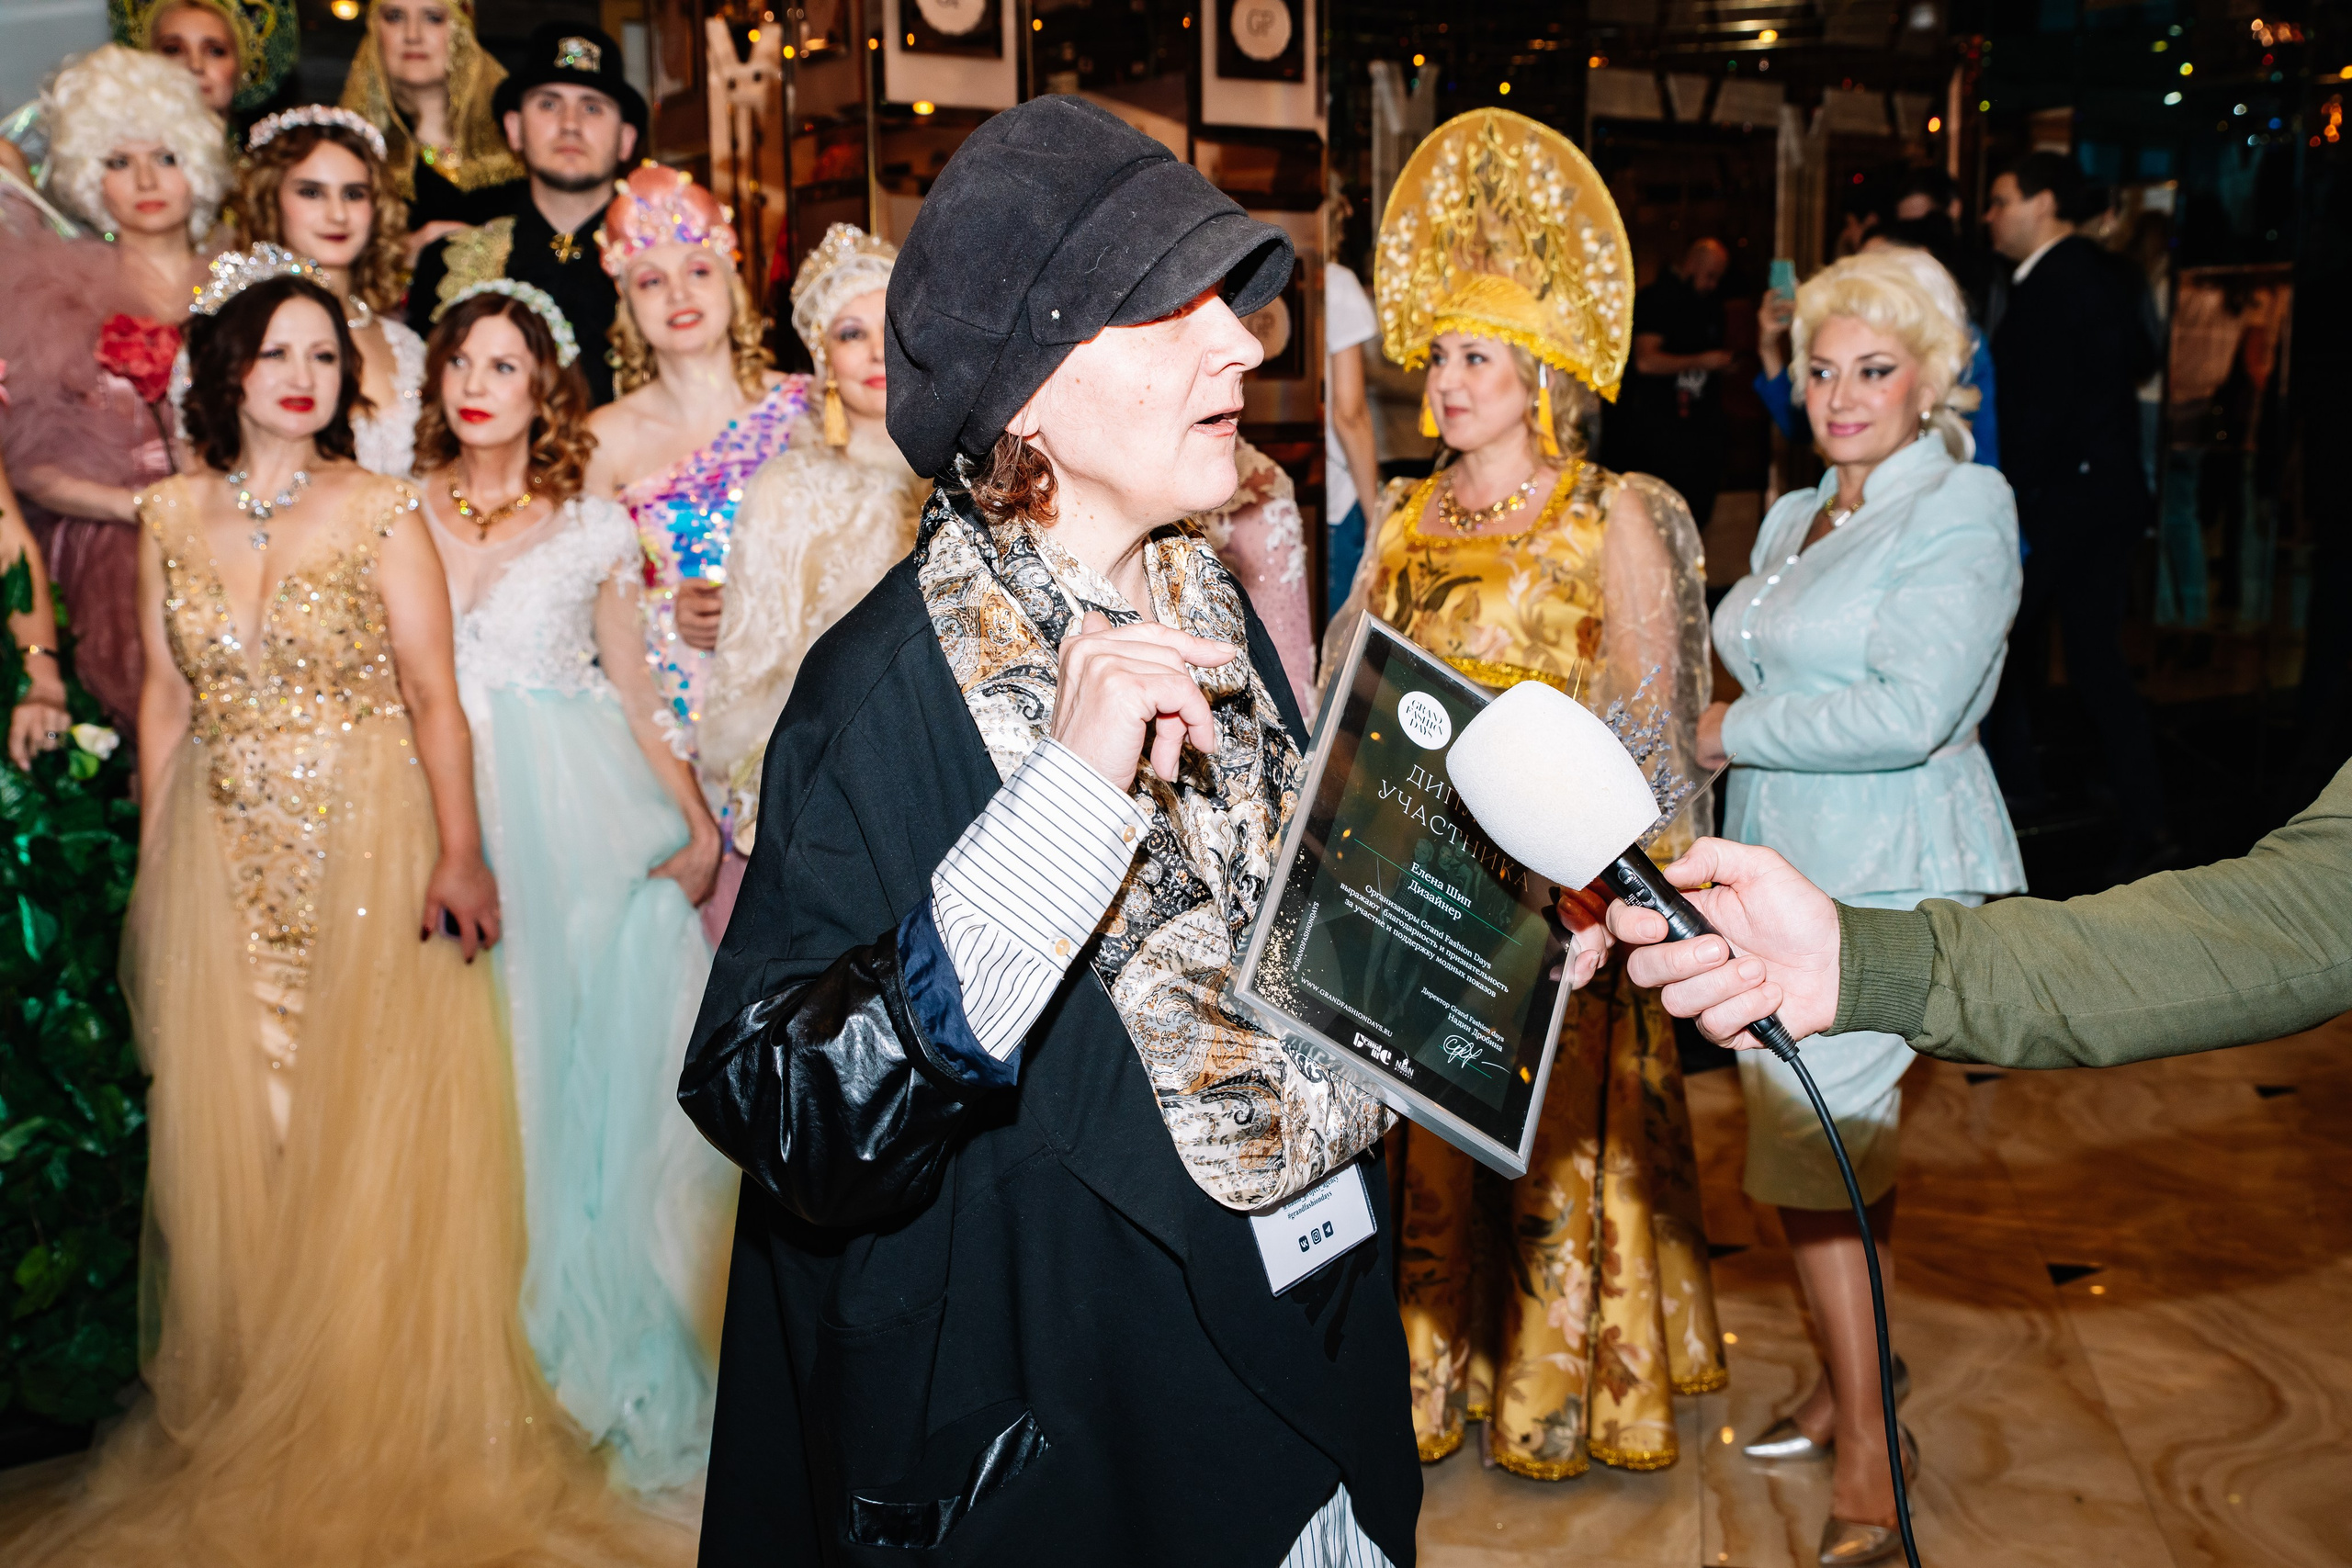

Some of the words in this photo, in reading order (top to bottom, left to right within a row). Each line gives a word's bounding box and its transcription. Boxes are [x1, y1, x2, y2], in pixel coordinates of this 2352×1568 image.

[1406, 706, 1442, 735] FASHION
[1410, 718, 1432, 738] DAYS
[1412, 700, 1442, 723] GRAND
[1378, 780, 1528, 891] УЧАСТНИКА
[1408, 880, 1461, 920] Дизайнер
[1411, 862, 1443, 890] Елена
[1446, 885, 1471, 908] Шип
[1293, 902, 1318, 971] #GRANDFASHIONDAYS
[1340, 883, 1380, 910] выражают
[1382, 909, 1438, 948] благодарность
[1446, 950, 1509, 992] признательность
[1345, 899, 1353, 908] за
[1354, 905, 1385, 928] участие
[1393, 930, 1435, 960] поддержку
[1436, 956, 1465, 978] модных
[1466, 976, 1496, 997] показов
[1365, 886, 1419, 923] Организаторы
[1421, 920, 1444, 939] Grand
[1444, 935, 1472, 957] Fashion
[1474, 953, 1491, 969] Days
[1302, 976, 1392, 1037] WWW.GRANDFASHIONDAYS.RU
[1421, 987, 1450, 1009] Директор
[1451, 1005, 1468, 1020] Grand
[1469, 1016, 1490, 1033] Fashion
[1491, 1030, 1505, 1043] days
[1448, 1013, 1471, 1032] Надин
[1472, 1029, 1502, 1052] Дробина
[1287, 1190, 1332, 1220] #grandfashiondays
